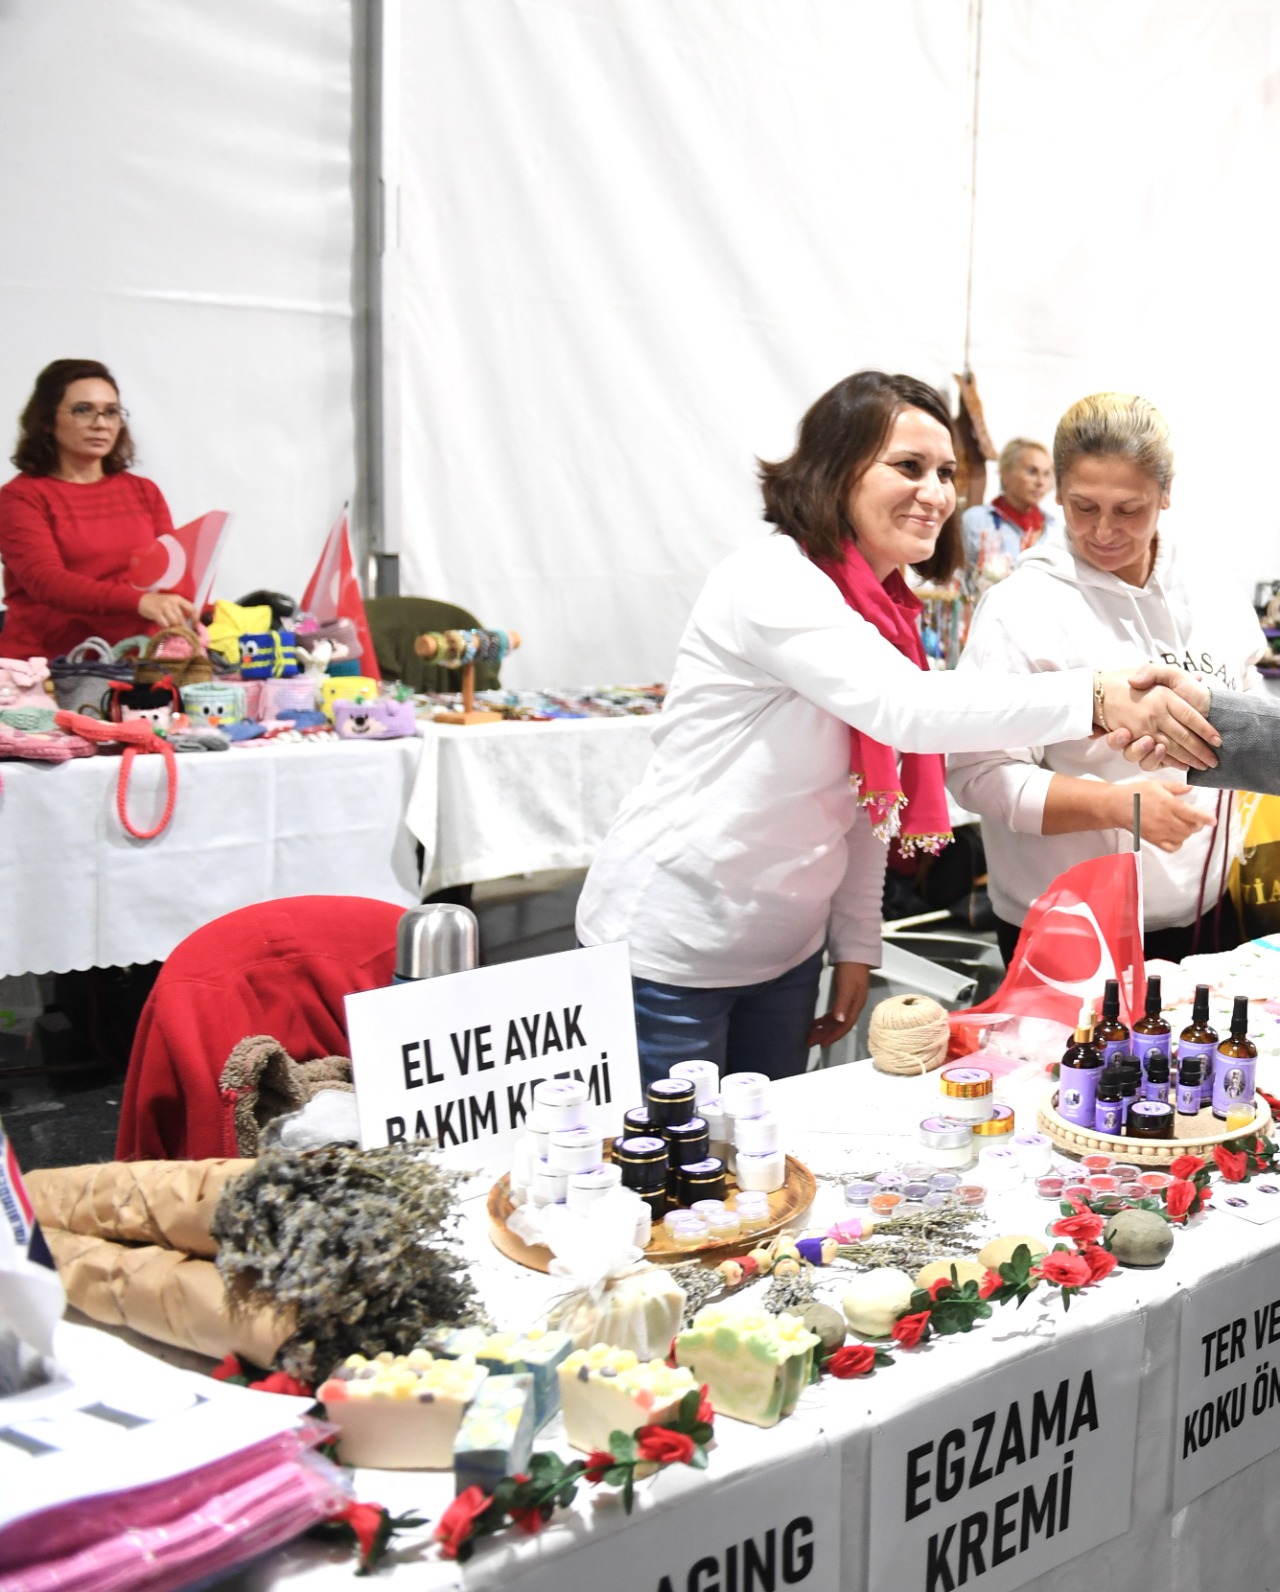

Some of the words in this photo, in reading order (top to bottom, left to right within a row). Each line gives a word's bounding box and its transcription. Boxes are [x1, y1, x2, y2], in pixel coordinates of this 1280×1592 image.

[401, 1038, 445, 1090] EL
[450, 1024, 495, 1076] VE
[504, 1004, 587, 1065] AYAK
[1201, 1317, 1247, 1378] TER
[905, 1369, 1099, 1523] EGZAMA
[1182, 1382, 1247, 1460] KOKU
[656, 1516, 815, 1592] GING
[926, 1449, 1075, 1592] KREMİ
